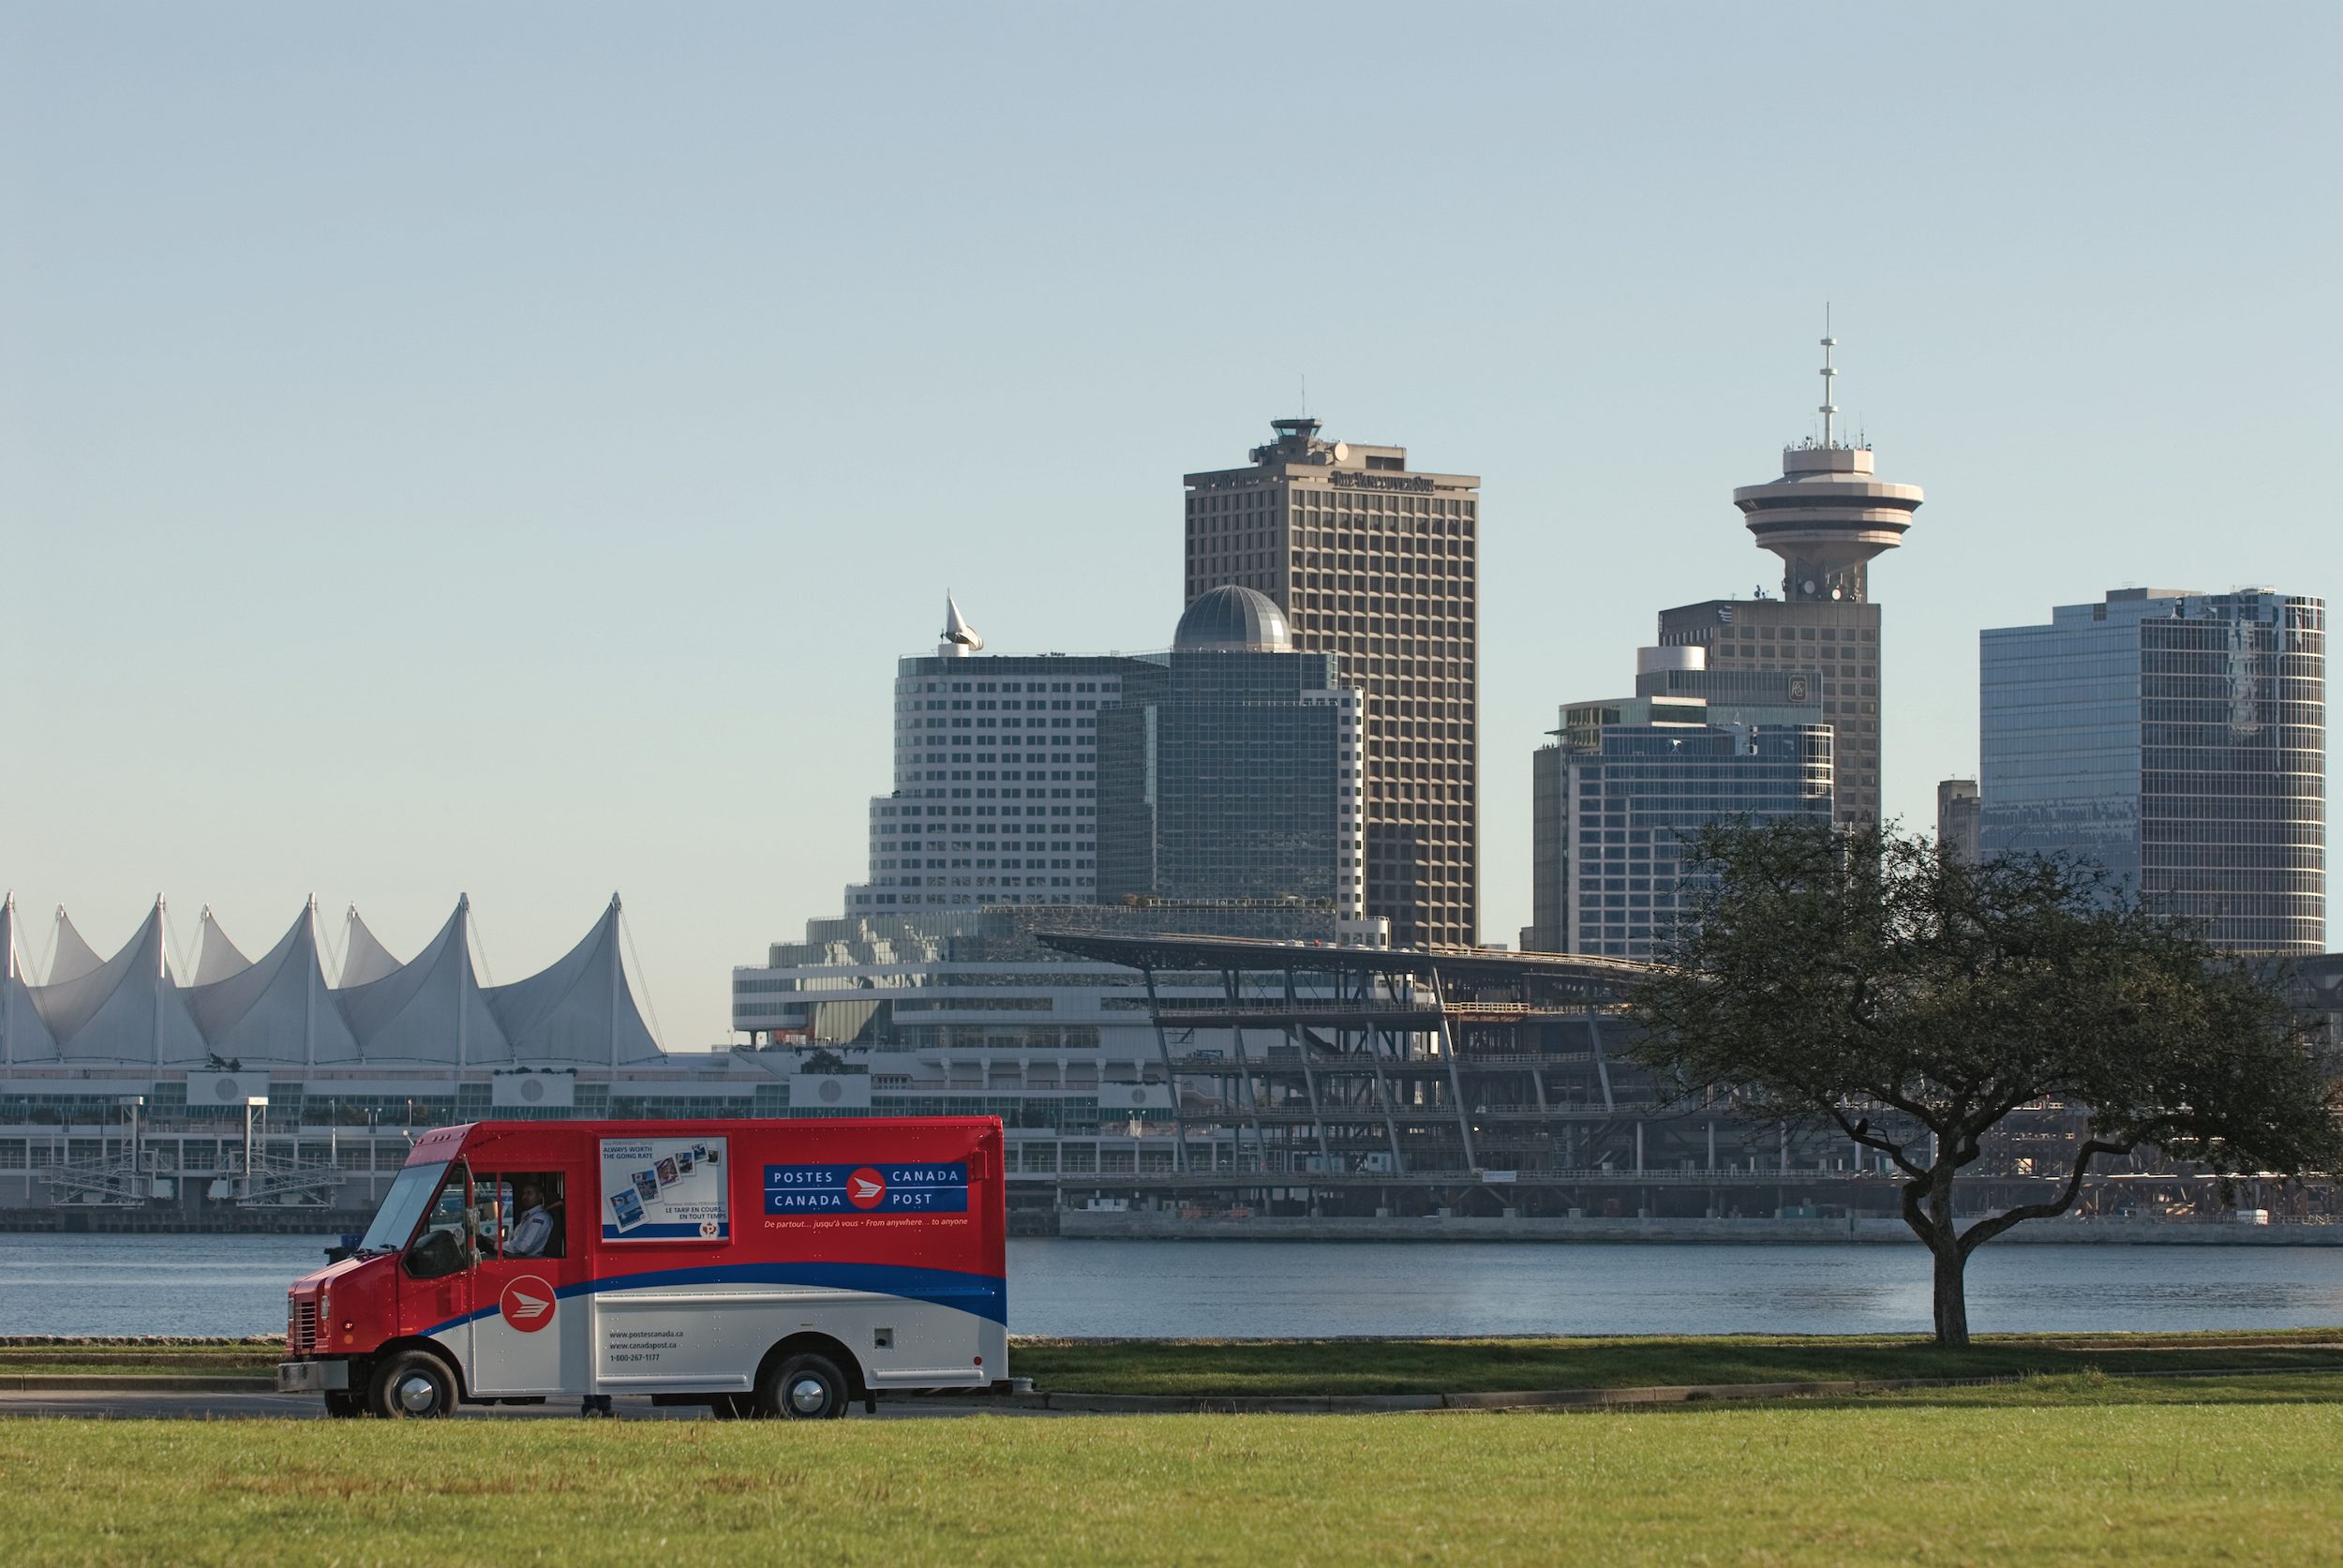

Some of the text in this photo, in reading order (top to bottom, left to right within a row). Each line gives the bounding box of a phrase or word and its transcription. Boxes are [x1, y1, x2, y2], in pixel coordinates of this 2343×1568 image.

[1331, 470, 1434, 492] THE VANCOUVER SUN
[774, 1172, 832, 1183] POSTES
[892, 1171, 959, 1182] CANADA
[774, 1195, 841, 1206] CANADA
[893, 1193, 933, 1204] POST
[776, 1220, 812, 1229] partout...
[609, 1330, 684, 1338] www.postescanada.ca
[609, 1341, 677, 1350] www.canadapost.ca
